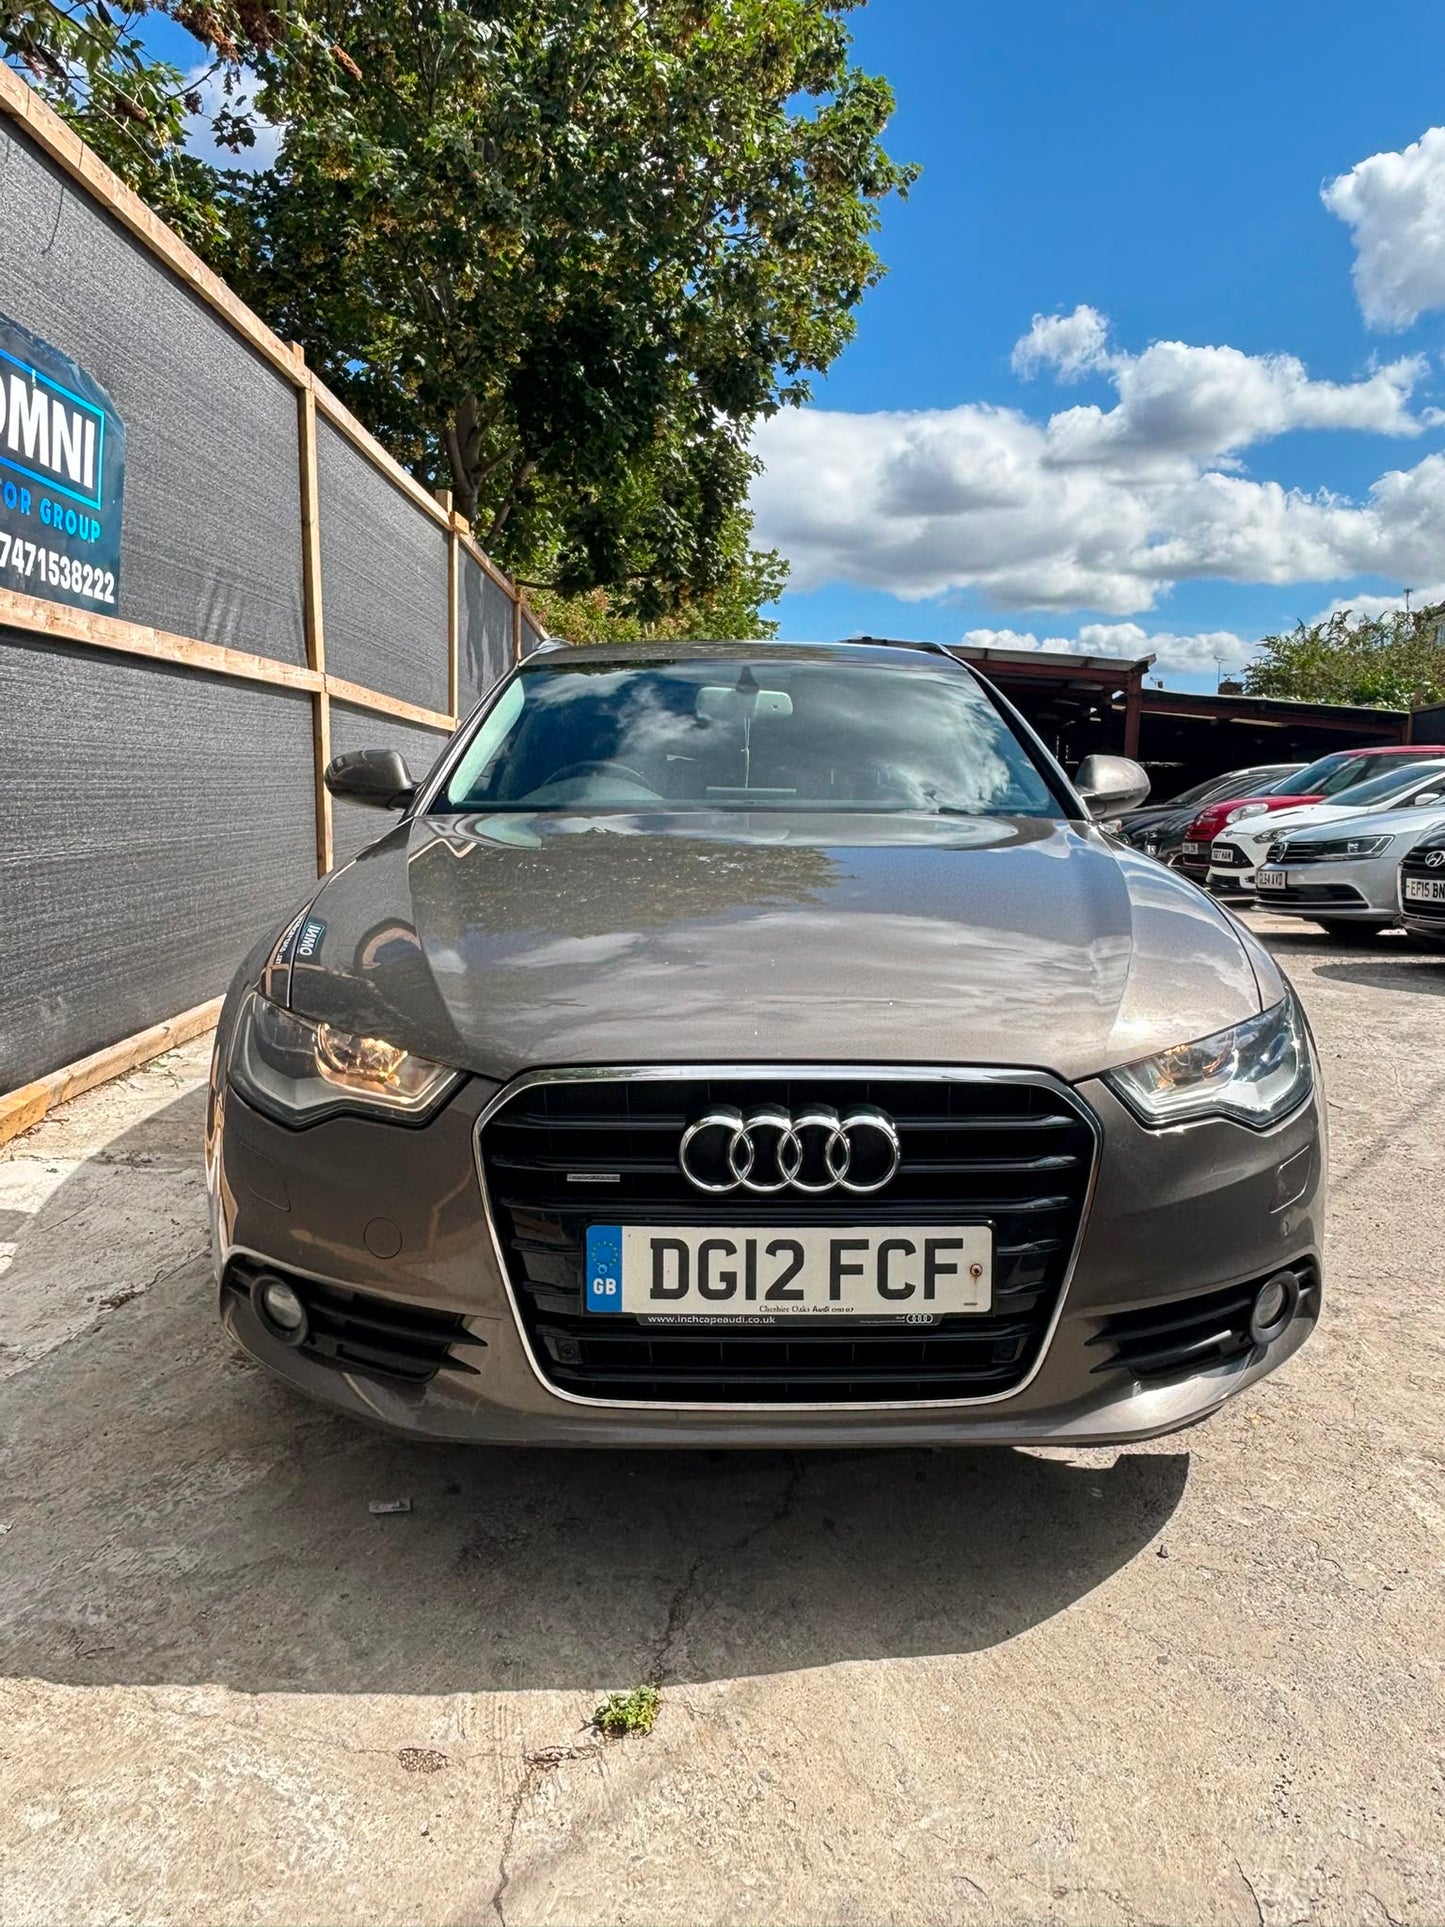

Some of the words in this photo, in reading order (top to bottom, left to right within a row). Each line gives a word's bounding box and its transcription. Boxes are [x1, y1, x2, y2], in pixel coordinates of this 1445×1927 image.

[0, 374, 95, 489] MNI
[0, 479, 31, 515] OR
[40, 498, 101, 543] GROUP
[0, 531, 115, 604] 7471538222
[1410, 881, 1430, 897] EF15
[1432, 882, 1445, 899] BN
[592, 1277, 617, 1296] GB
[649, 1237, 805, 1301] DG12
[829, 1237, 964, 1301] FCF
[647, 1315, 776, 1325] www.inchcapeaudi.co.uk
